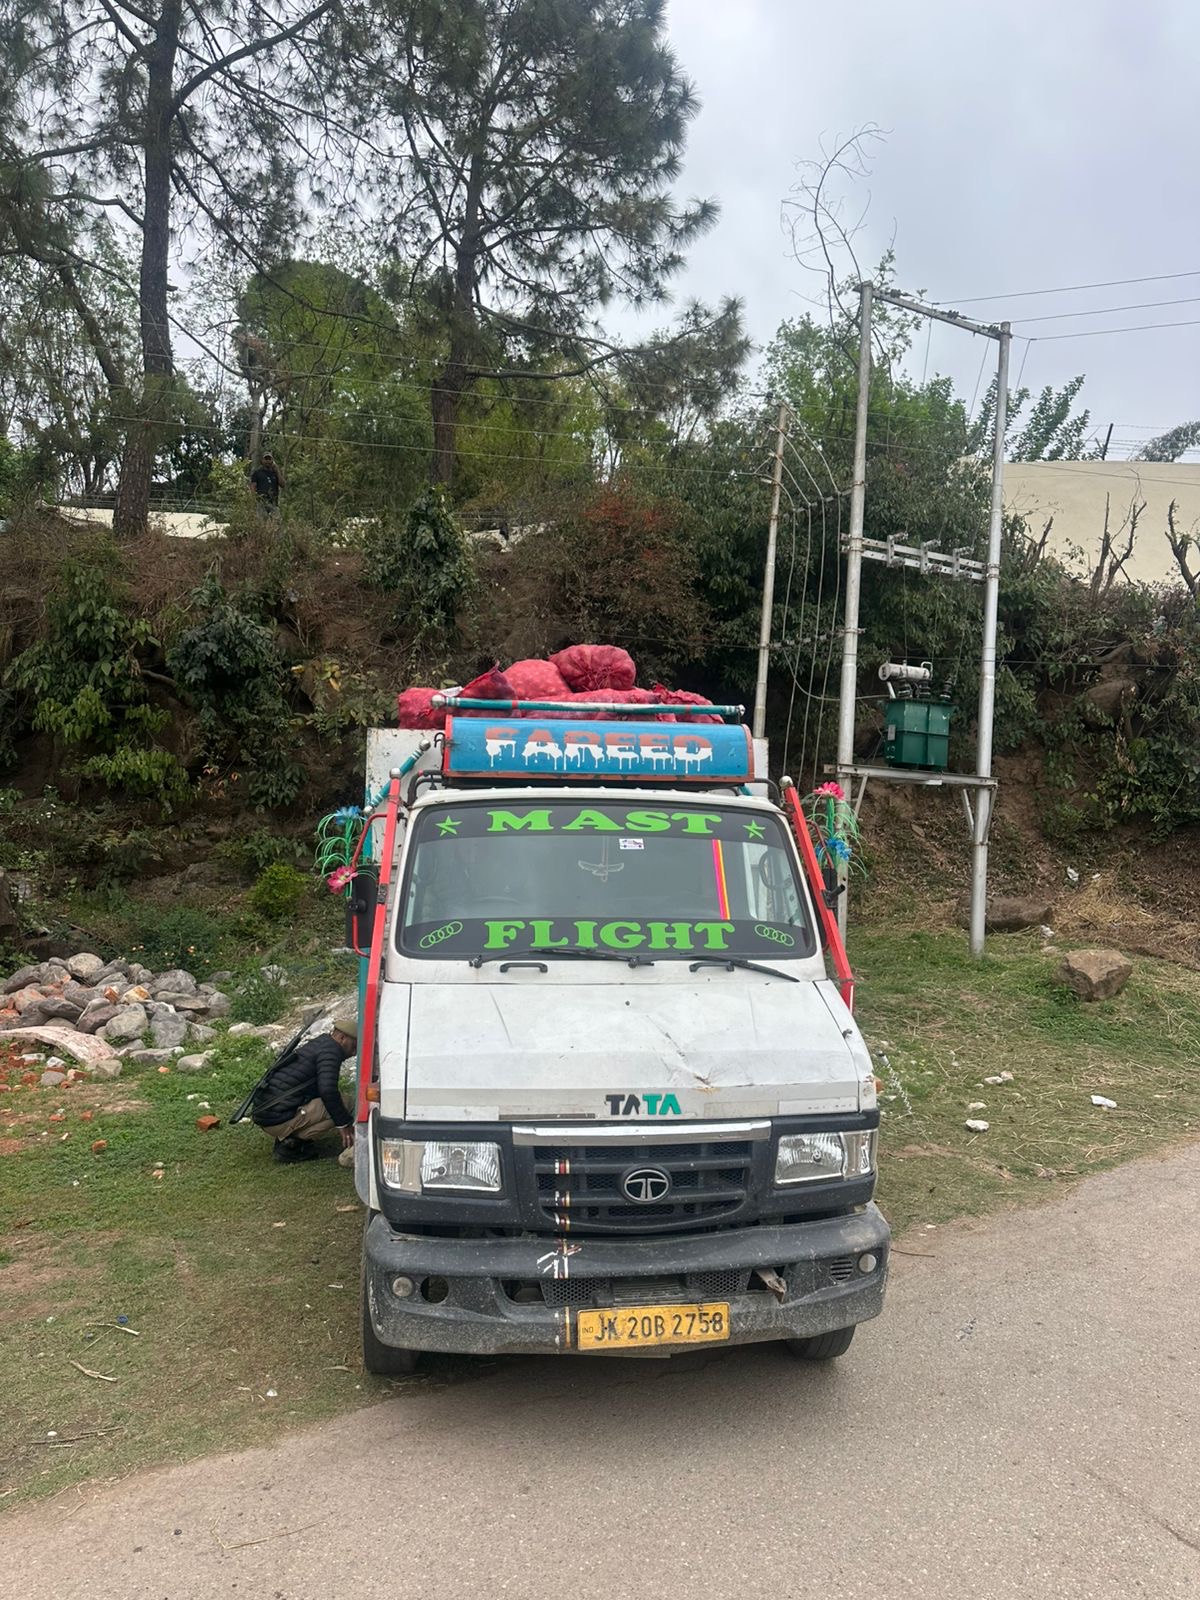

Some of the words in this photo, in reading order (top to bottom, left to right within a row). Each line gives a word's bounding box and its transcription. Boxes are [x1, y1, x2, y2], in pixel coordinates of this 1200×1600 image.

[484, 726, 713, 774] FAREED
[487, 808, 722, 835] MAST
[484, 920, 735, 950] FLIGHT
[605, 1093, 682, 1116] TATA
[595, 1313, 618, 1341] JK
[627, 1315, 665, 1338] 20B
[672, 1312, 723, 1336] 2758
